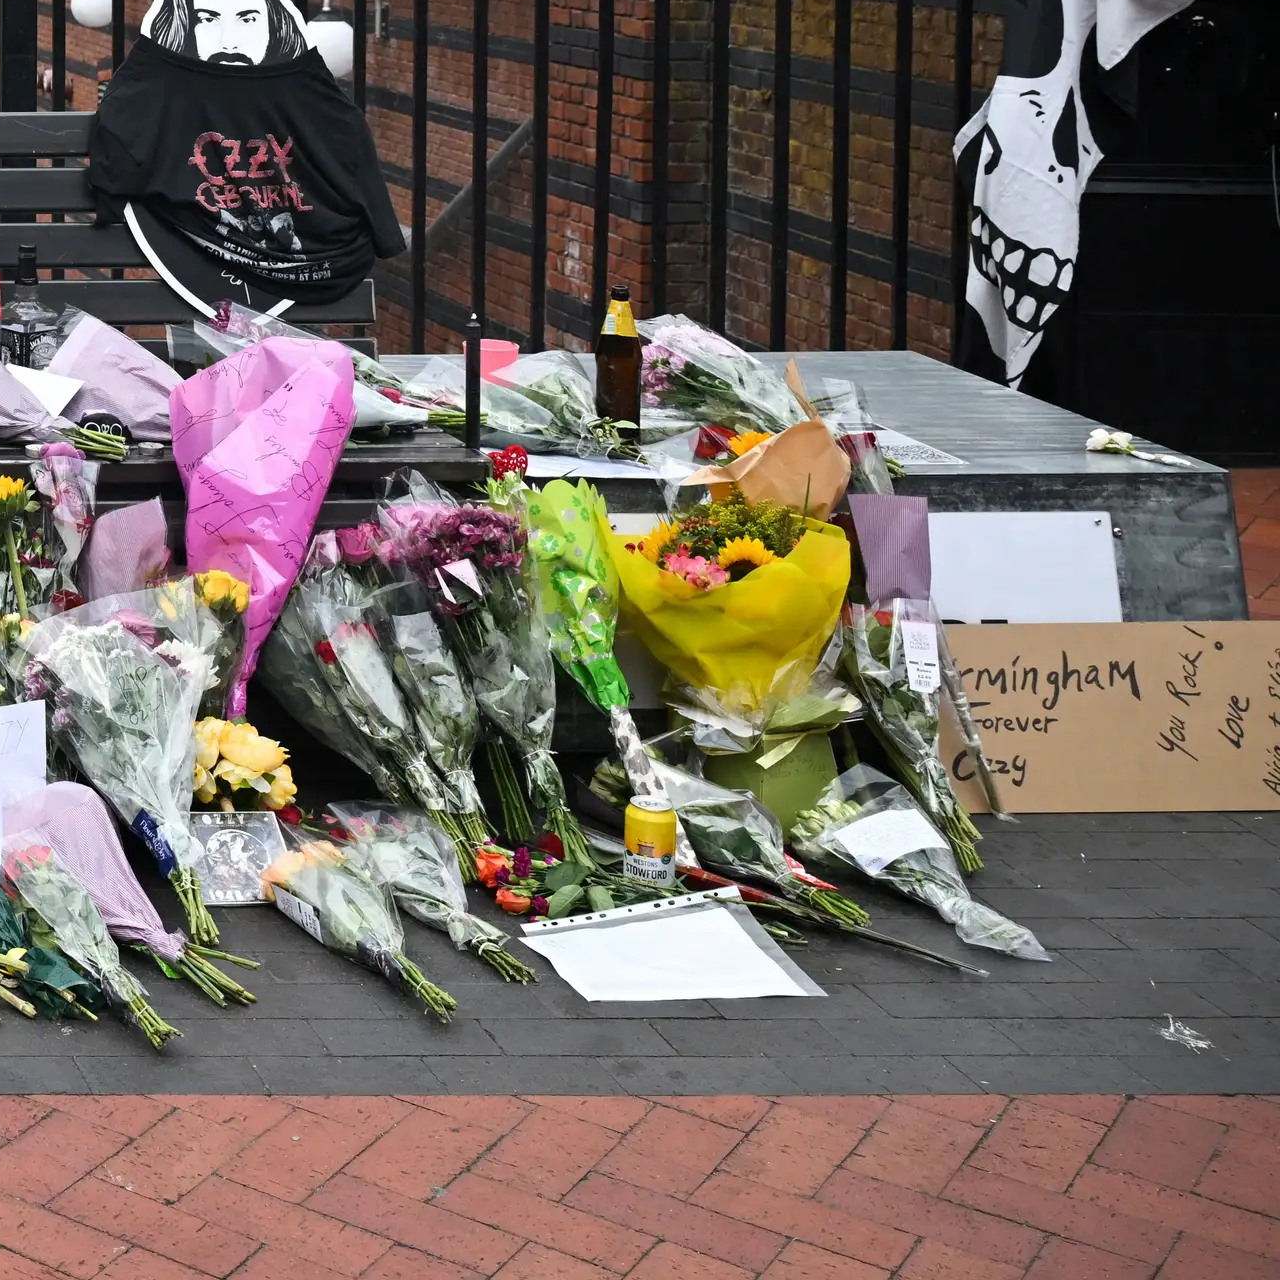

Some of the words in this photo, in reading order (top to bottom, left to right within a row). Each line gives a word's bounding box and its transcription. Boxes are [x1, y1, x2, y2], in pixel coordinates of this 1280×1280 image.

[188, 131, 293, 185] OZZY
[196, 182, 313, 212] OSBOURNE
[1156, 716, 1198, 762] You
[625, 863, 668, 880] STOWFORD
[633, 858, 658, 868] WESTONS
